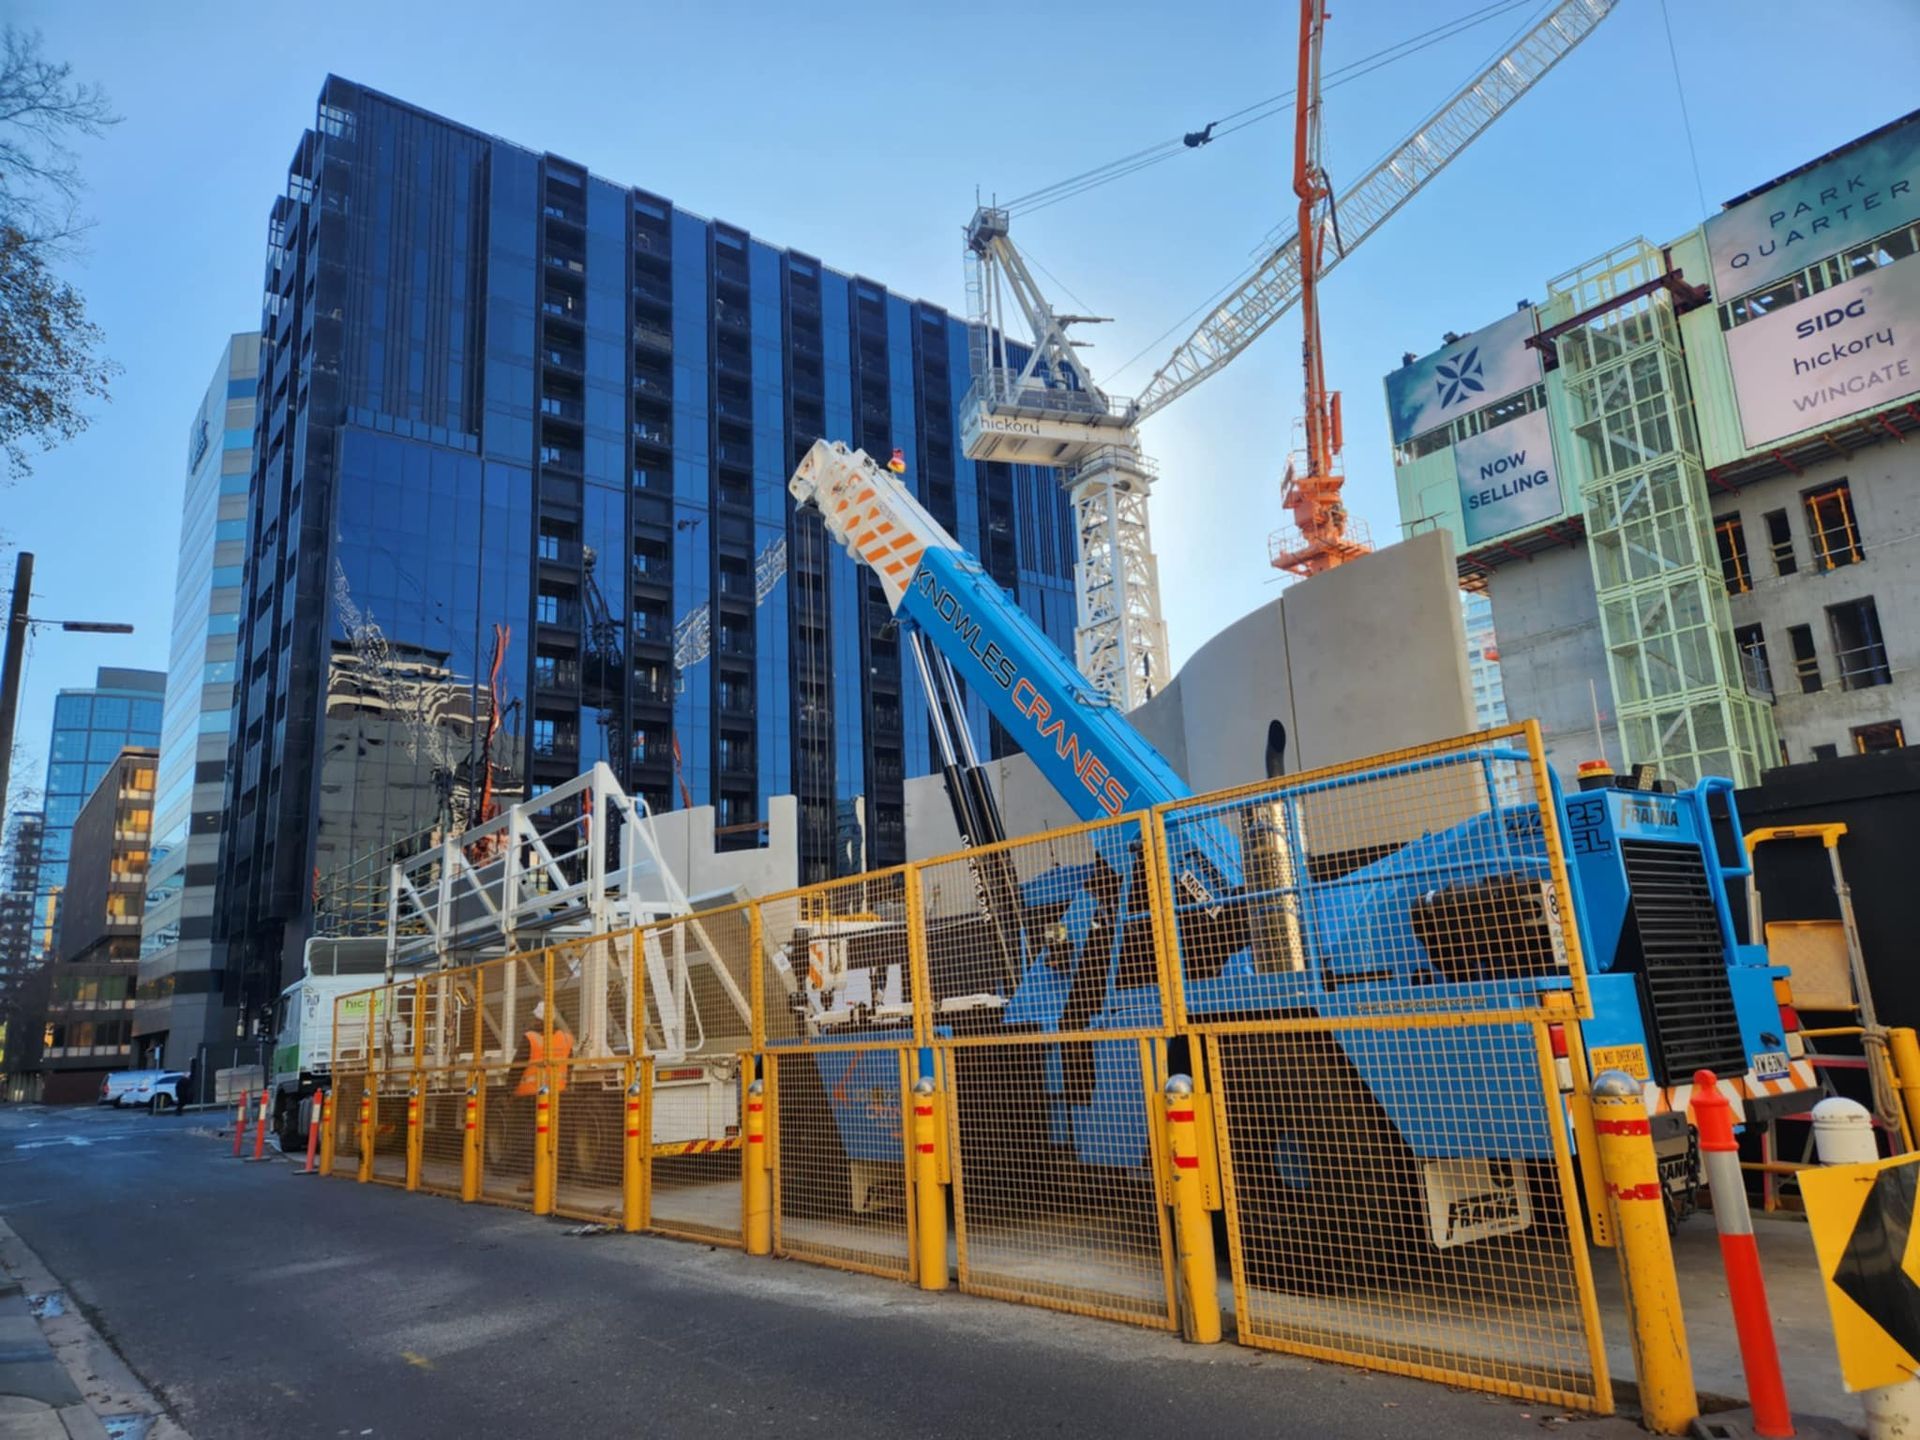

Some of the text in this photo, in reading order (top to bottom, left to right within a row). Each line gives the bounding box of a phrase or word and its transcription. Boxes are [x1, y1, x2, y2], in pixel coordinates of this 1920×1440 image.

[1769, 174, 1865, 229] PARK
[1730, 180, 1911, 269] QUARTER
[1796, 299, 1866, 340] SIDG
[1793, 327, 1895, 375] hickory
[1792, 358, 1911, 412] WINGATE
[980, 415, 1040, 435] hickory
[1480, 449, 1527, 480] NOW
[1468, 469, 1550, 510] SELLING
[912, 563, 1129, 816] KNOWLES CRANES
[1566, 799, 1606, 829] 25
